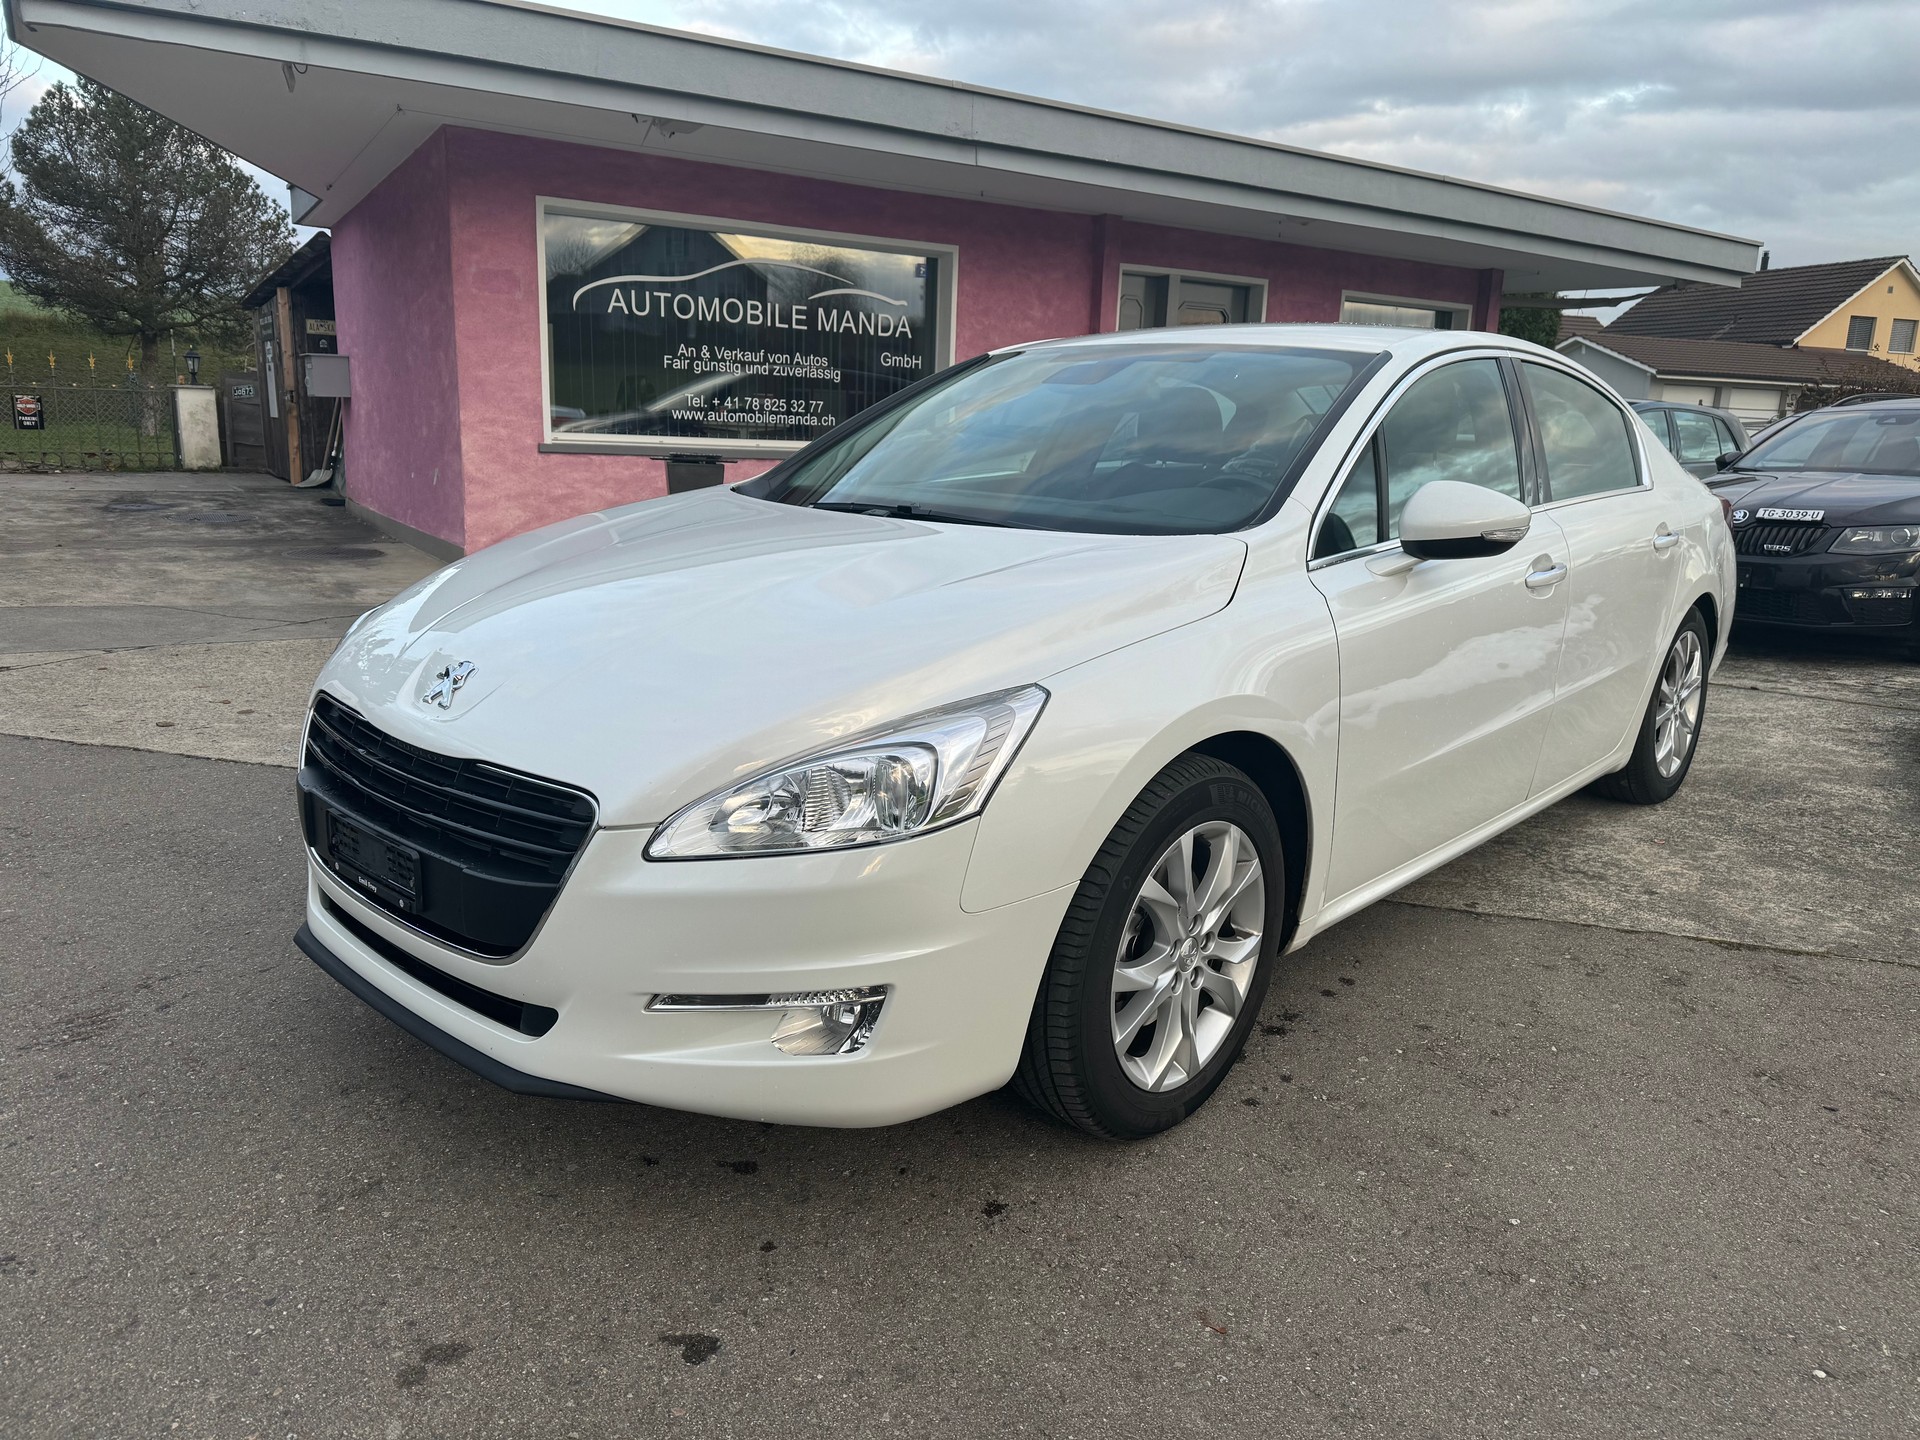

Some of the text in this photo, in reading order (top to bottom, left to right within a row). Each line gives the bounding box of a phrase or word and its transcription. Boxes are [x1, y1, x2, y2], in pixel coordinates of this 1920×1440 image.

[607, 288, 912, 339] AUTOMOBILE MANDA
[677, 343, 829, 367] An & Verkauf von Autos
[880, 352, 922, 369] GmbH
[663, 355, 841, 383] Fair günstig und zuverlässig
[685, 393, 824, 414] Tel. + 41 78 825 32 77
[671, 409, 836, 426] www.automobilemanda.ch
